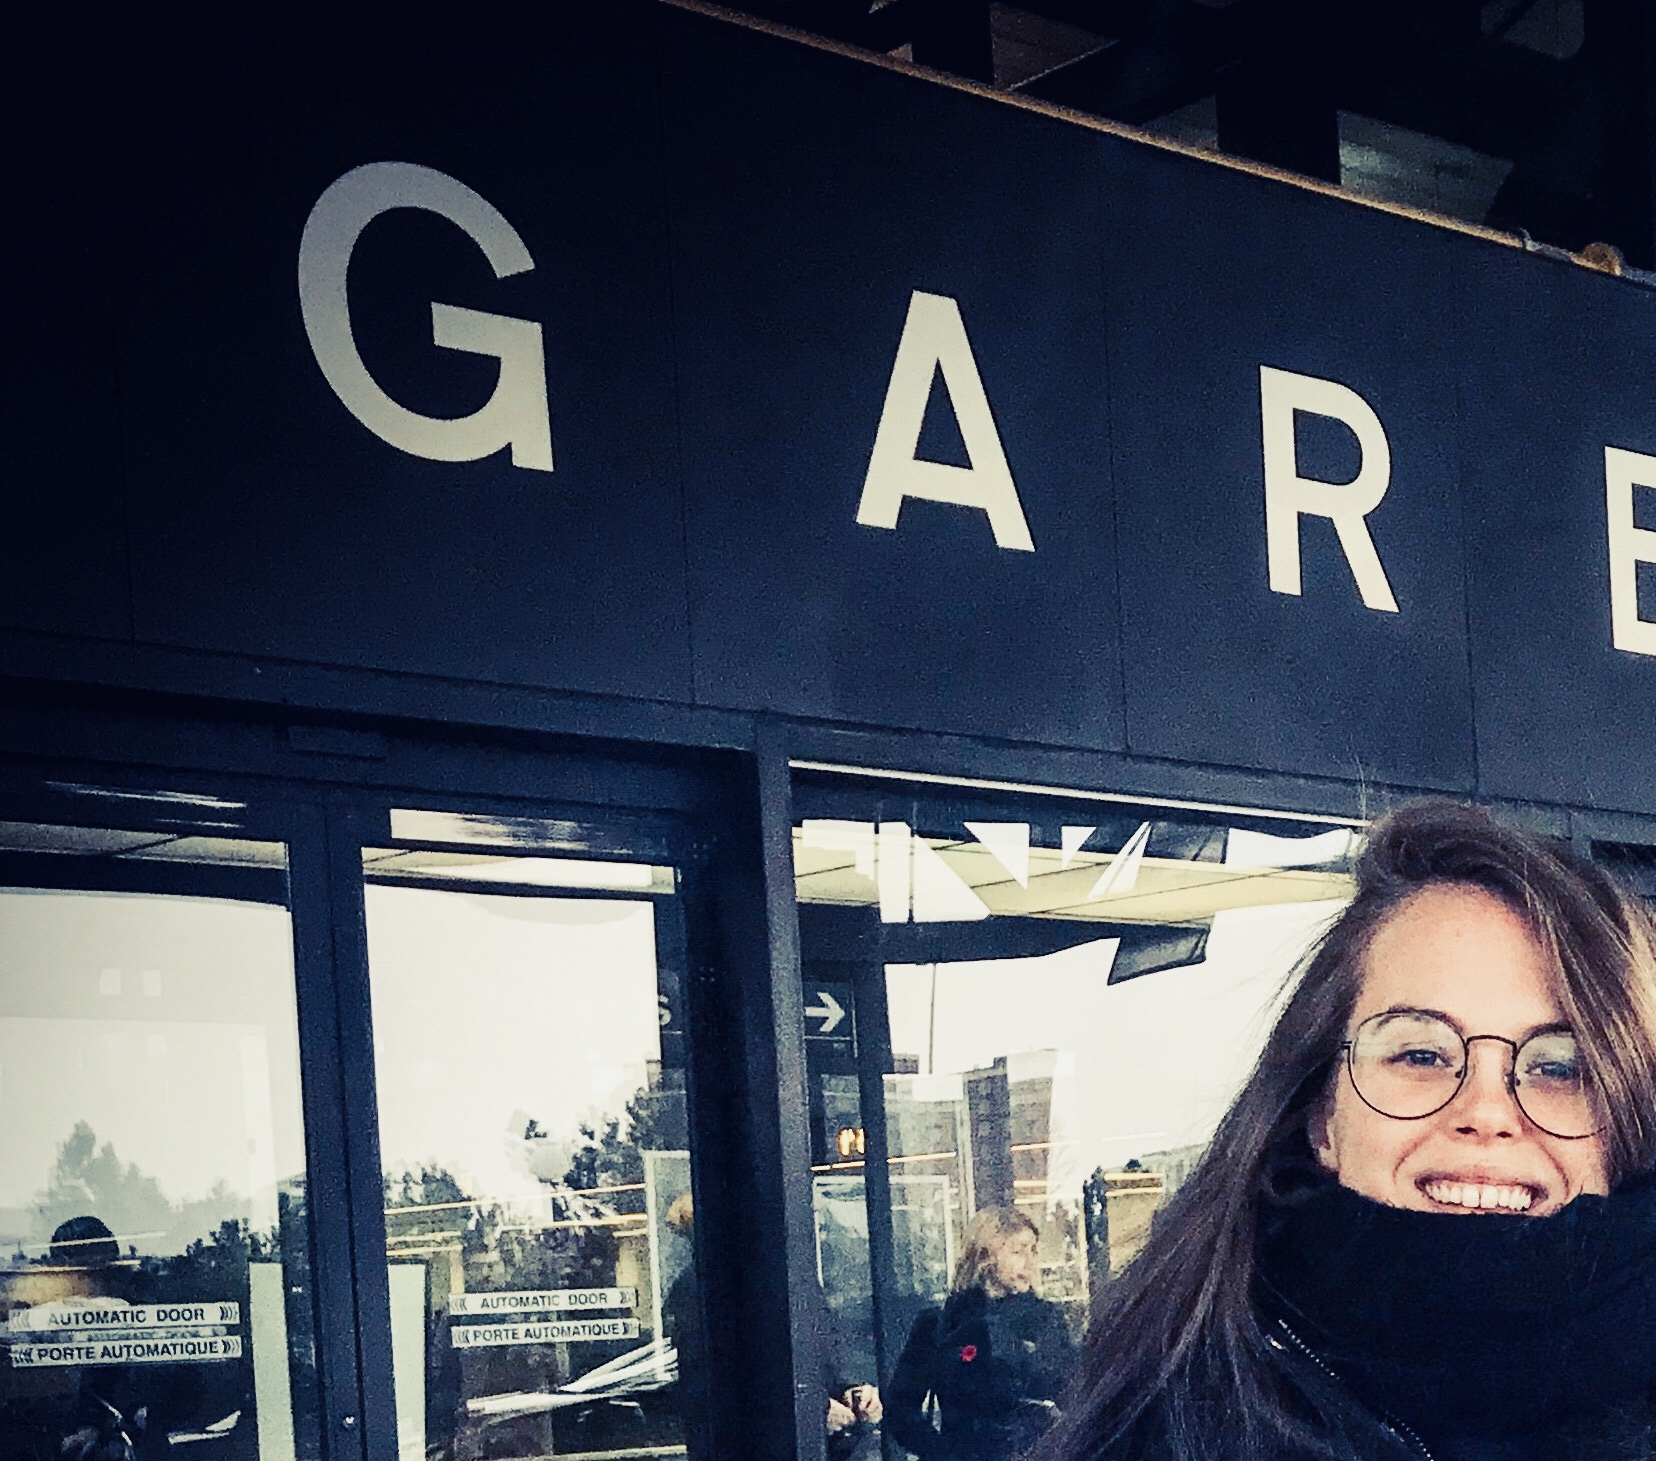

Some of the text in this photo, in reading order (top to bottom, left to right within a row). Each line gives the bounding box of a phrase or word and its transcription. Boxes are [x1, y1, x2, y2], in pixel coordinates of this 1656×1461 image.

[480, 1293, 608, 1309] AUTOMATIC DOOR
[48, 1307, 205, 1326] AUTOMATIC DOOR
[473, 1323, 619, 1342] PORTE AUTOMATIQUE
[37, 1340, 218, 1361] PORTE AUTOMATIQUE
